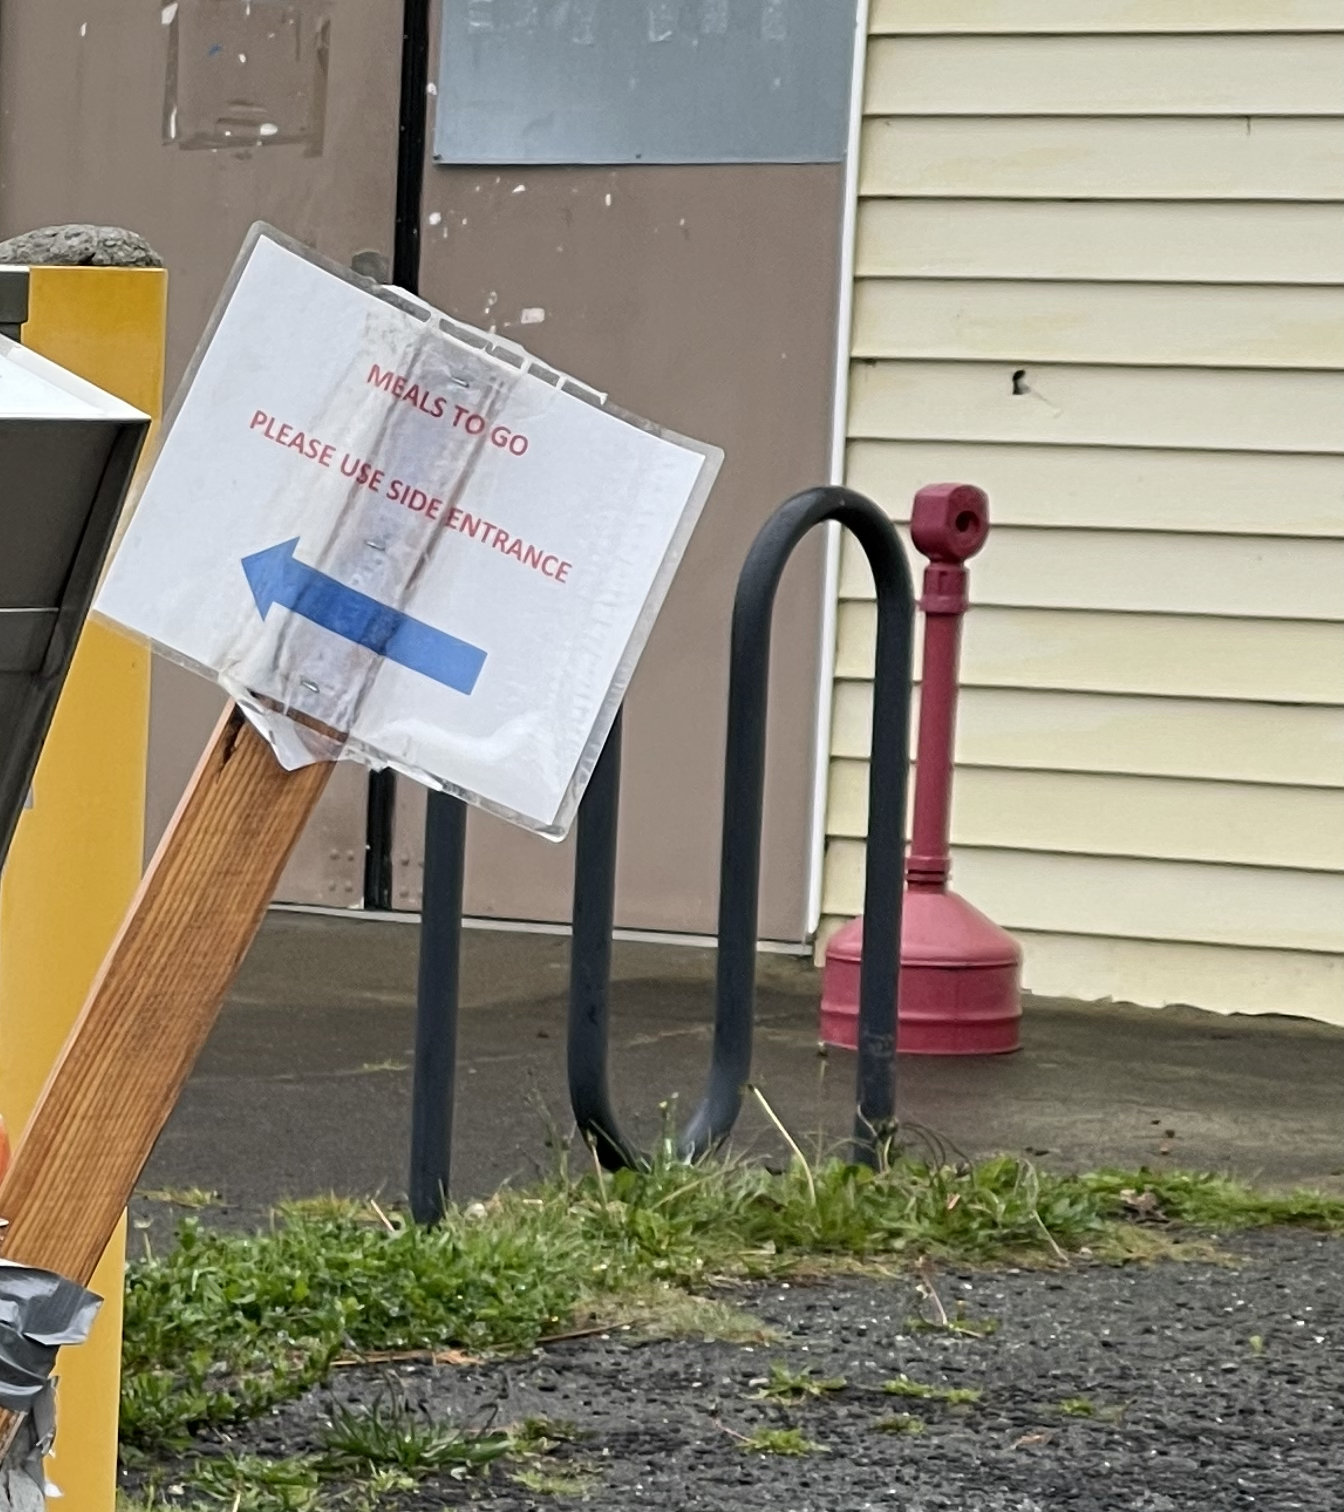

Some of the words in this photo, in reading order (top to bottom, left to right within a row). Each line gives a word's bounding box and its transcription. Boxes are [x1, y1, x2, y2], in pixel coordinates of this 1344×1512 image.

[367, 364, 448, 419] MEALS
[450, 404, 485, 434] TO
[491, 426, 529, 456] GO
[249, 409, 336, 467] PLEASE
[340, 454, 385, 492] USE
[386, 480, 443, 520] SIDE
[444, 506, 573, 583] ENTRANCE
